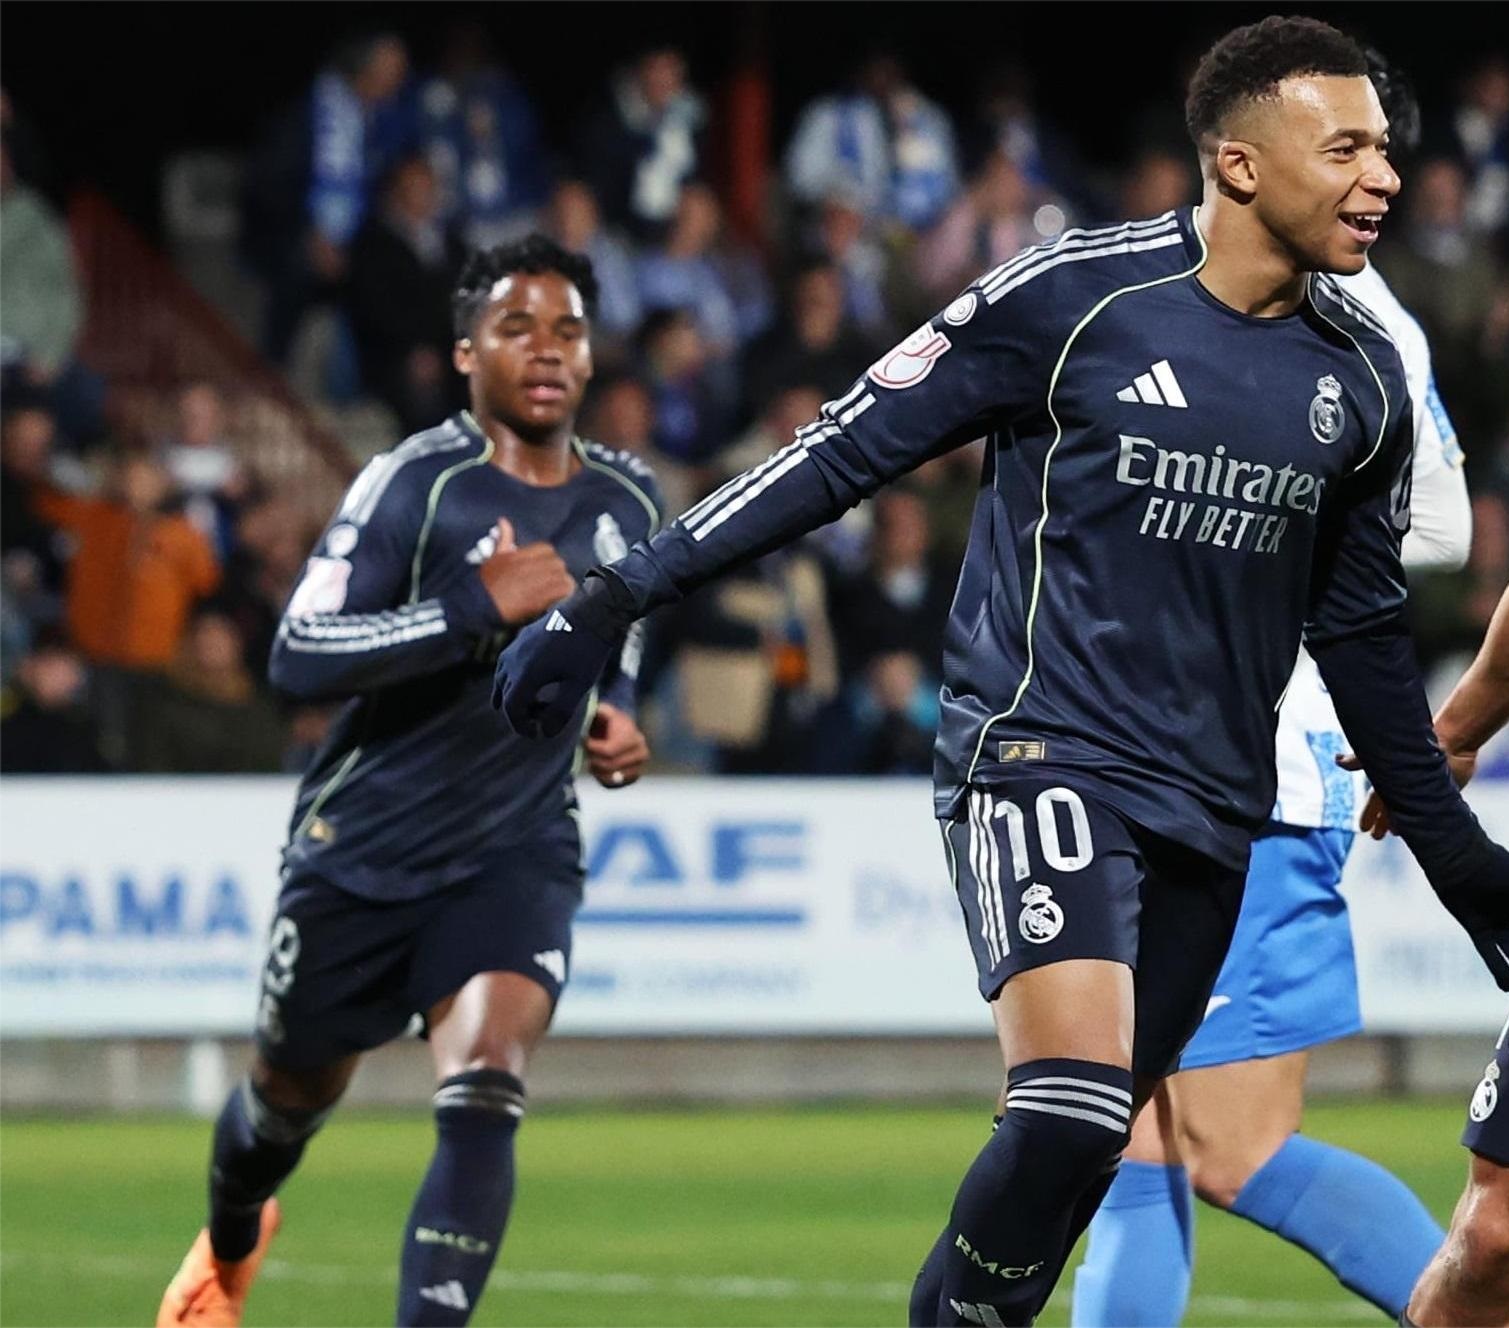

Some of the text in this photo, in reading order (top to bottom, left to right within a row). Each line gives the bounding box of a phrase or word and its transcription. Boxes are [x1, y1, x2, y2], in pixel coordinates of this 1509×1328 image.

[1116, 434, 1326, 515] Emirates
[1139, 496, 1288, 554] FLY BETTER
[993, 787, 1094, 882] 10
